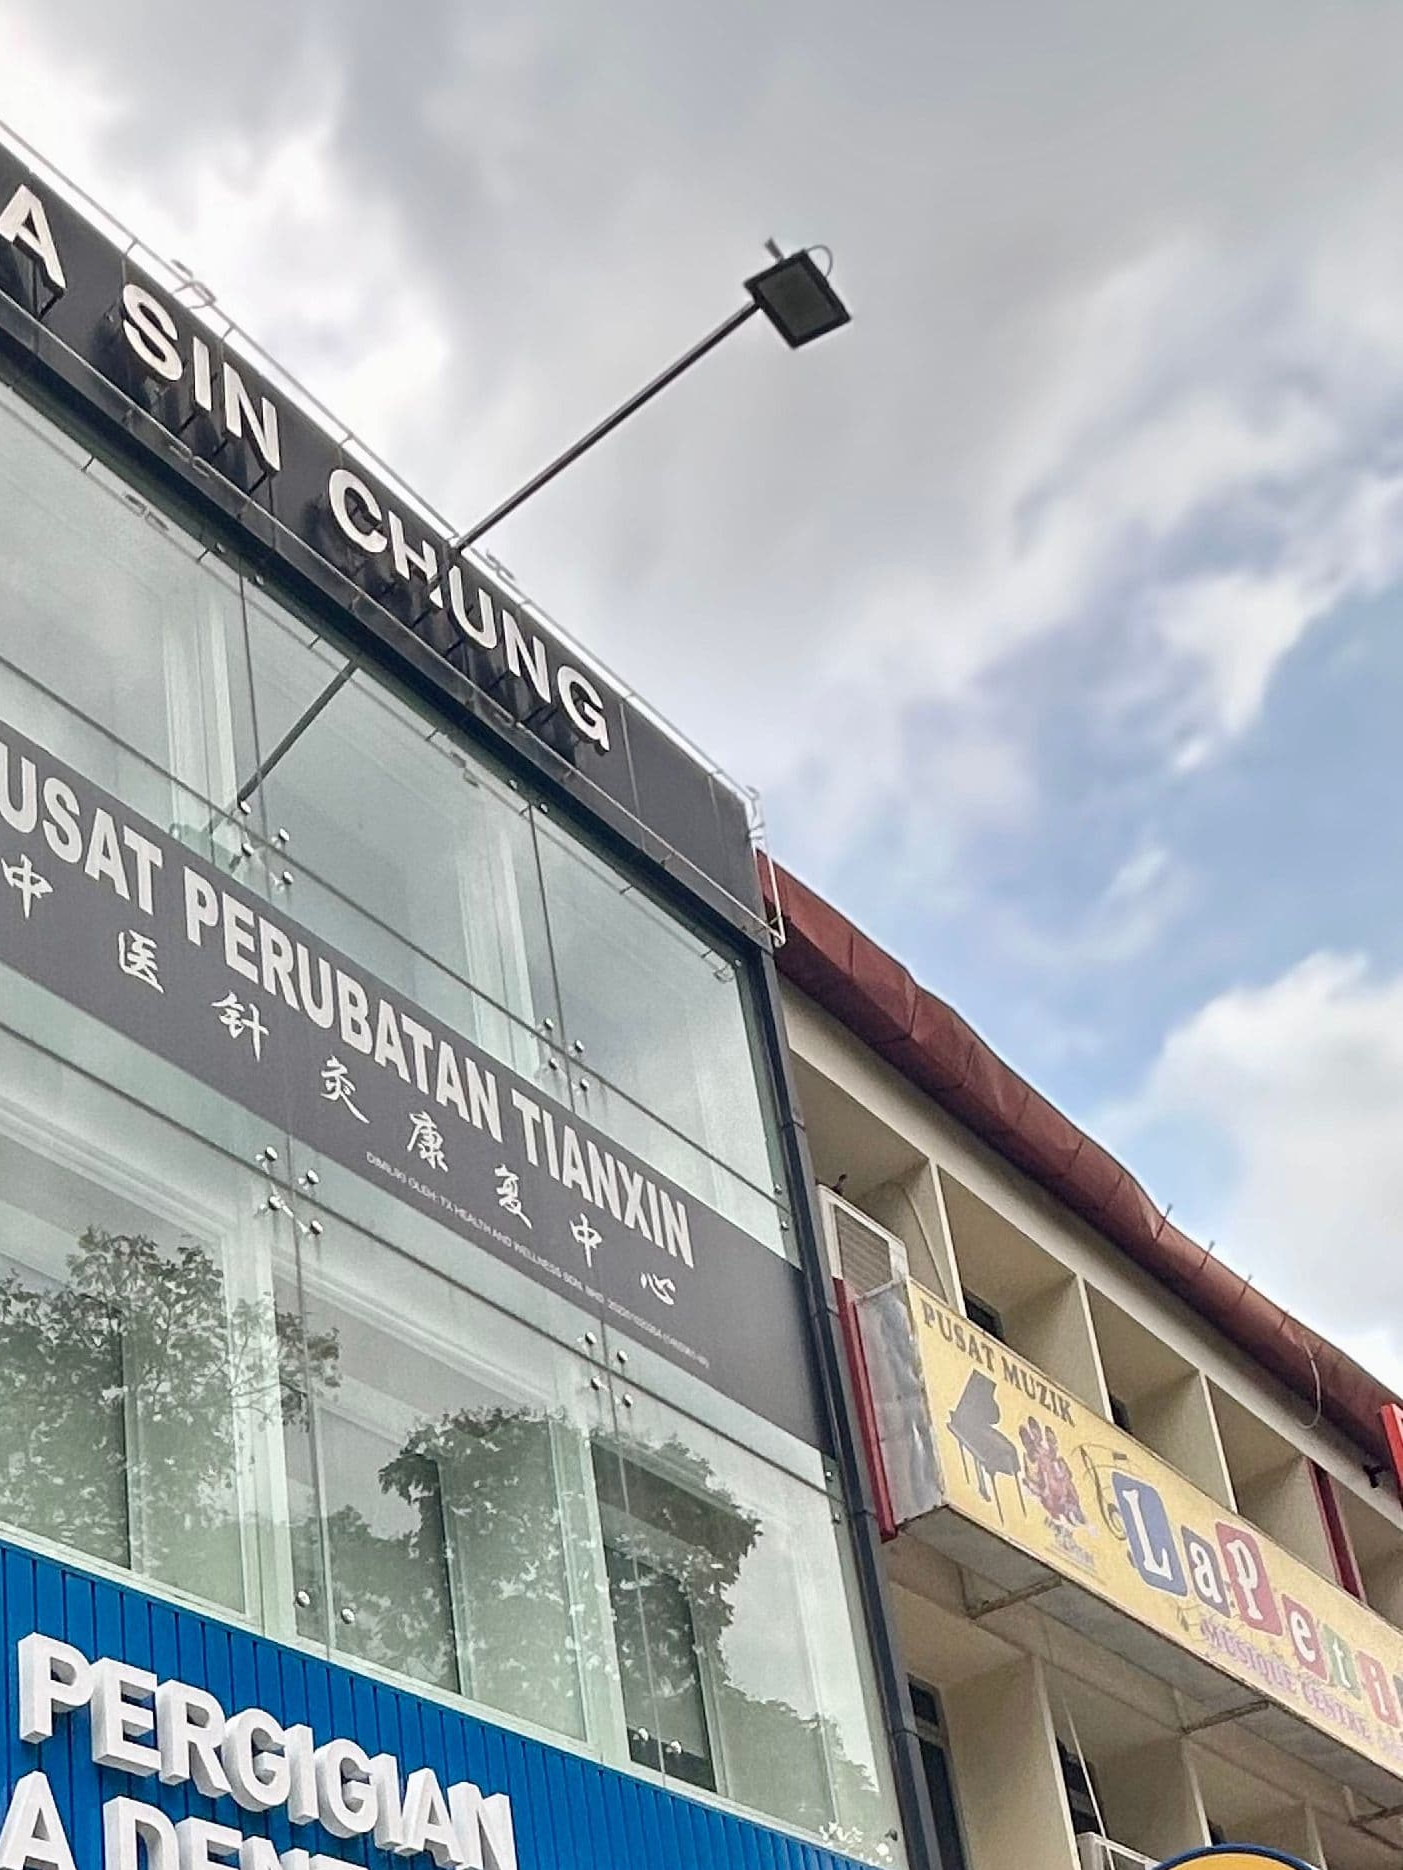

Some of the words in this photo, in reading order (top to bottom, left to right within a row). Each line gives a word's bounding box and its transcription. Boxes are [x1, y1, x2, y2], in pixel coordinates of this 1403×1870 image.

[123, 283, 280, 471] SIN
[328, 468, 610, 752] CHUNG
[183, 865, 503, 1143] PERUBATAN
[512, 1087, 694, 1268] TIANXIN
[921, 1299, 995, 1372] PUSAT
[1001, 1356, 1076, 1428] MUZIK
